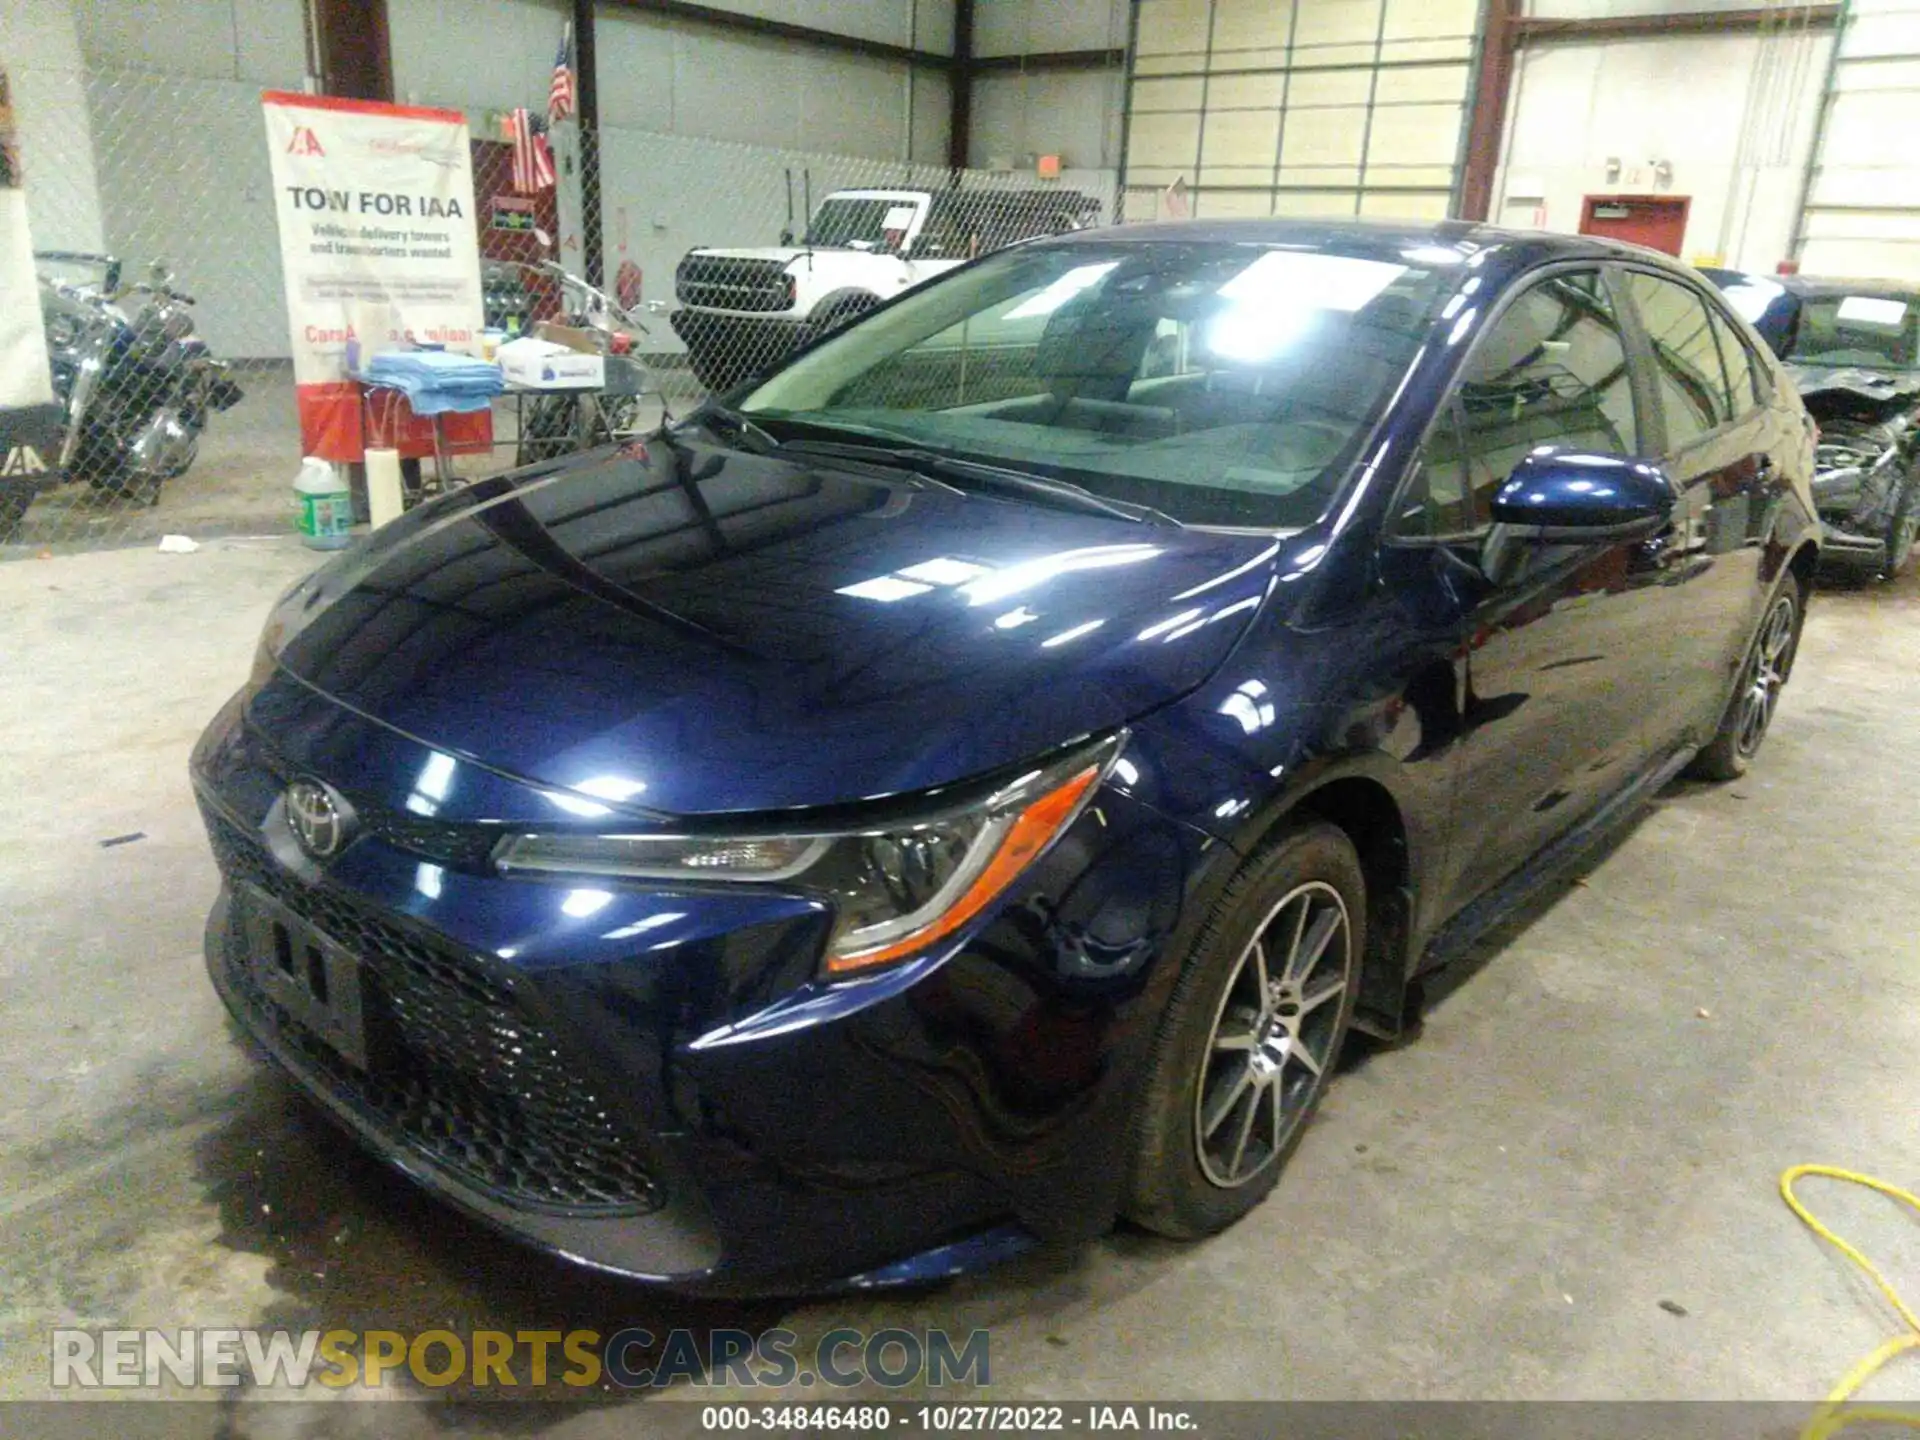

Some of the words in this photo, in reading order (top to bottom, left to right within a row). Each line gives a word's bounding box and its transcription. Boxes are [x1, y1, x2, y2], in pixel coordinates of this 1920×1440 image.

[286, 186, 349, 213] TOW
[359, 192, 412, 216] FOR
[419, 195, 463, 219] IAA
[359, 225, 409, 242] delivery
[310, 241, 334, 255] and
[335, 242, 407, 258] tranorters
